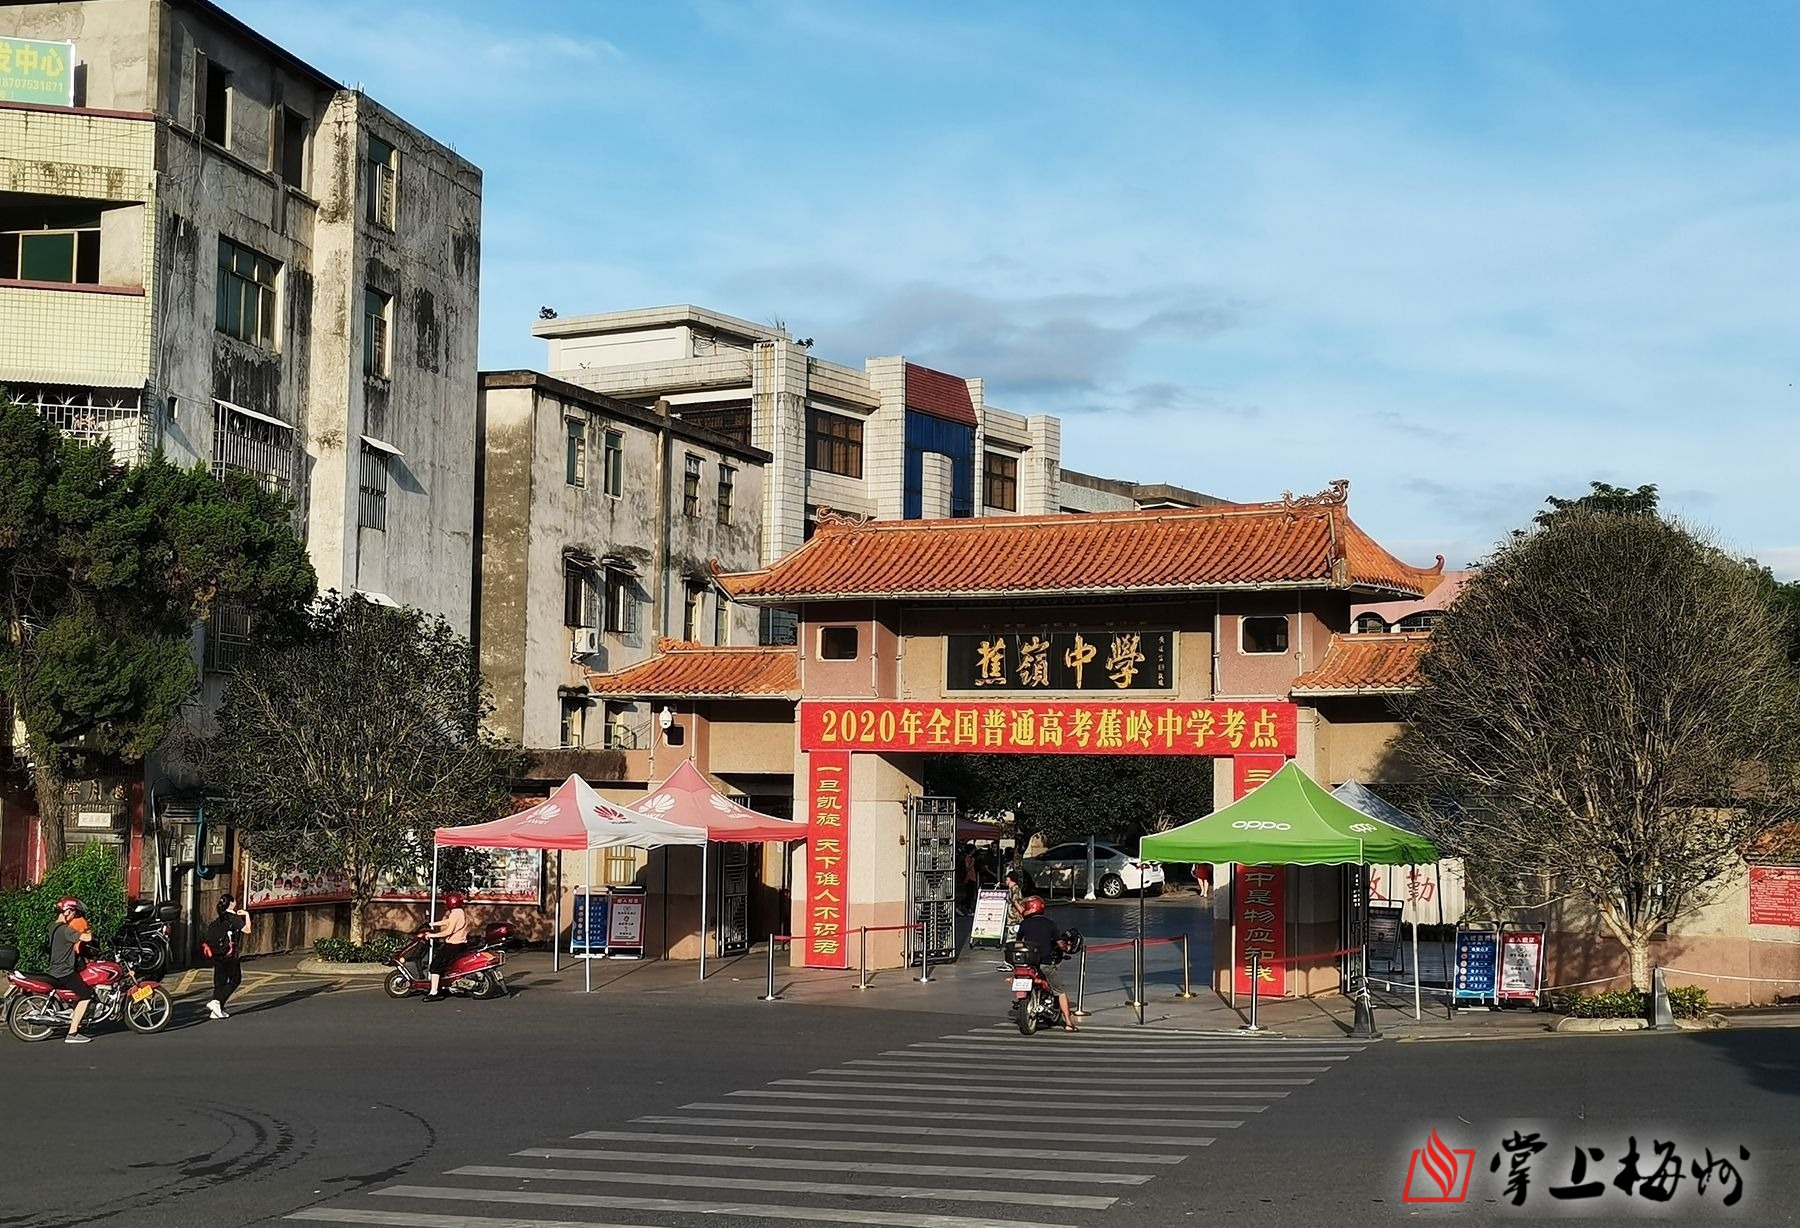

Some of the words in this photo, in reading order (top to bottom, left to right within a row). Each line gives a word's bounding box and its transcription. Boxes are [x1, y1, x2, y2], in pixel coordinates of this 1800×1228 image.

[974, 632, 1146, 690] 蕉嶺中學
[821, 708, 1279, 748] 2020年全国普通高考蕉岭中学考点
[815, 766, 843, 828] 一旦凯旋
[812, 838, 843, 955] 天下谁人不识君
